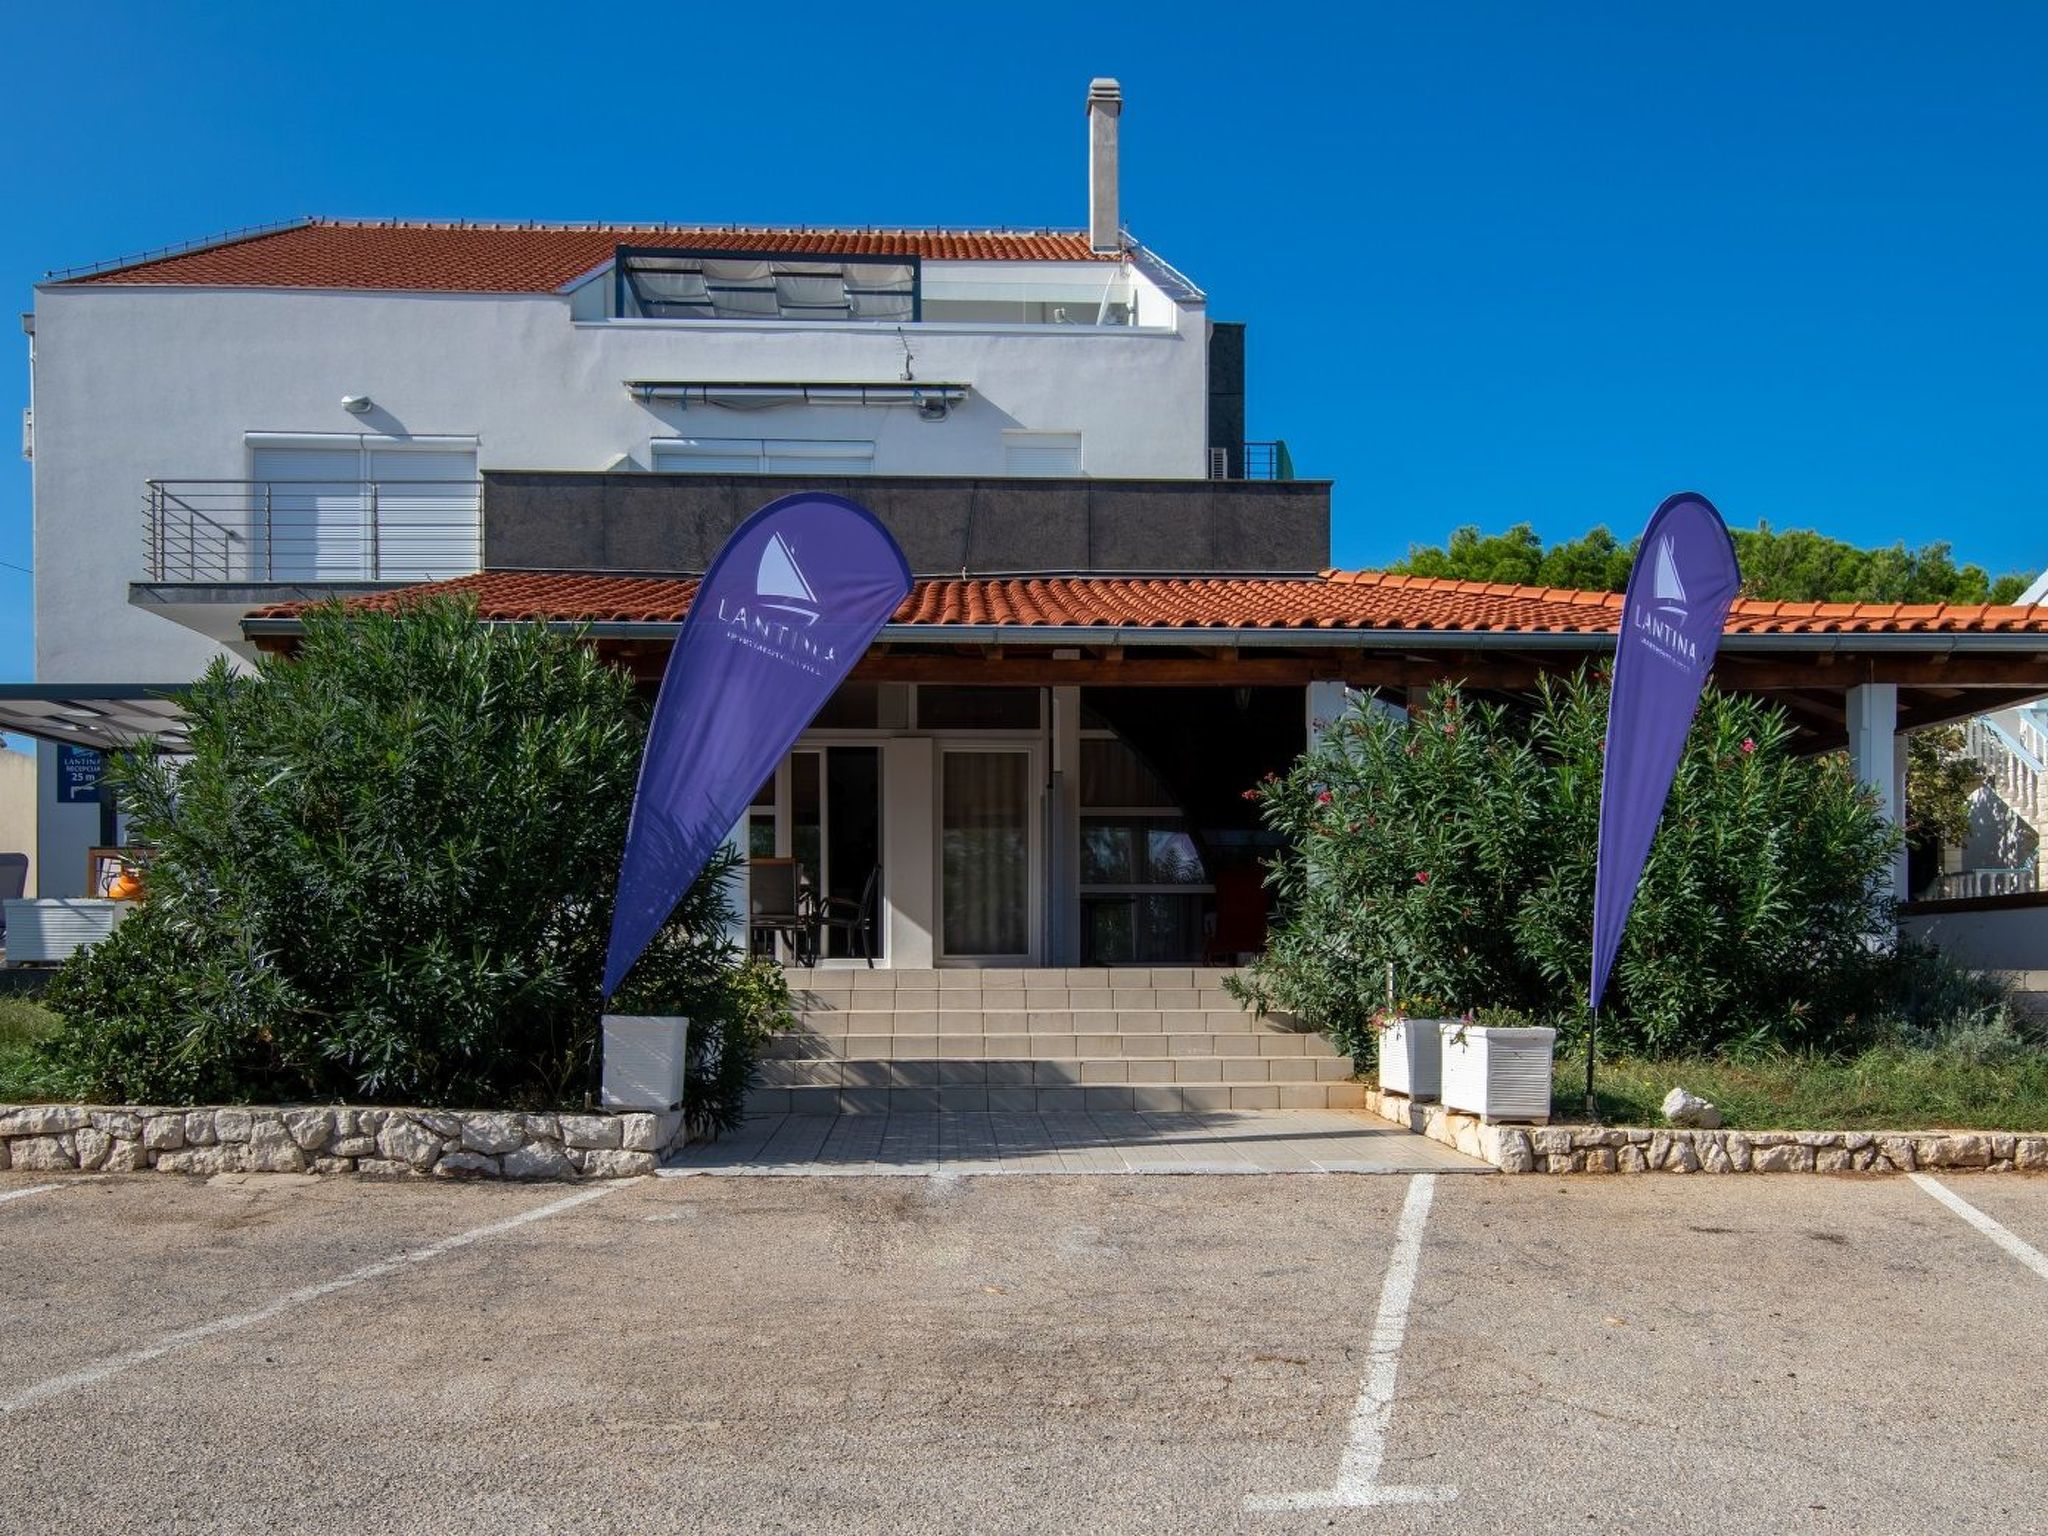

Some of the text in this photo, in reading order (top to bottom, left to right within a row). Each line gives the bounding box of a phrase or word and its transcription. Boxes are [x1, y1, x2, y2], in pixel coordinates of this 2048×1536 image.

[719, 599, 835, 661] LANTINA
[1636, 604, 1696, 663] LANTINA
[72, 773, 83, 781] 25
